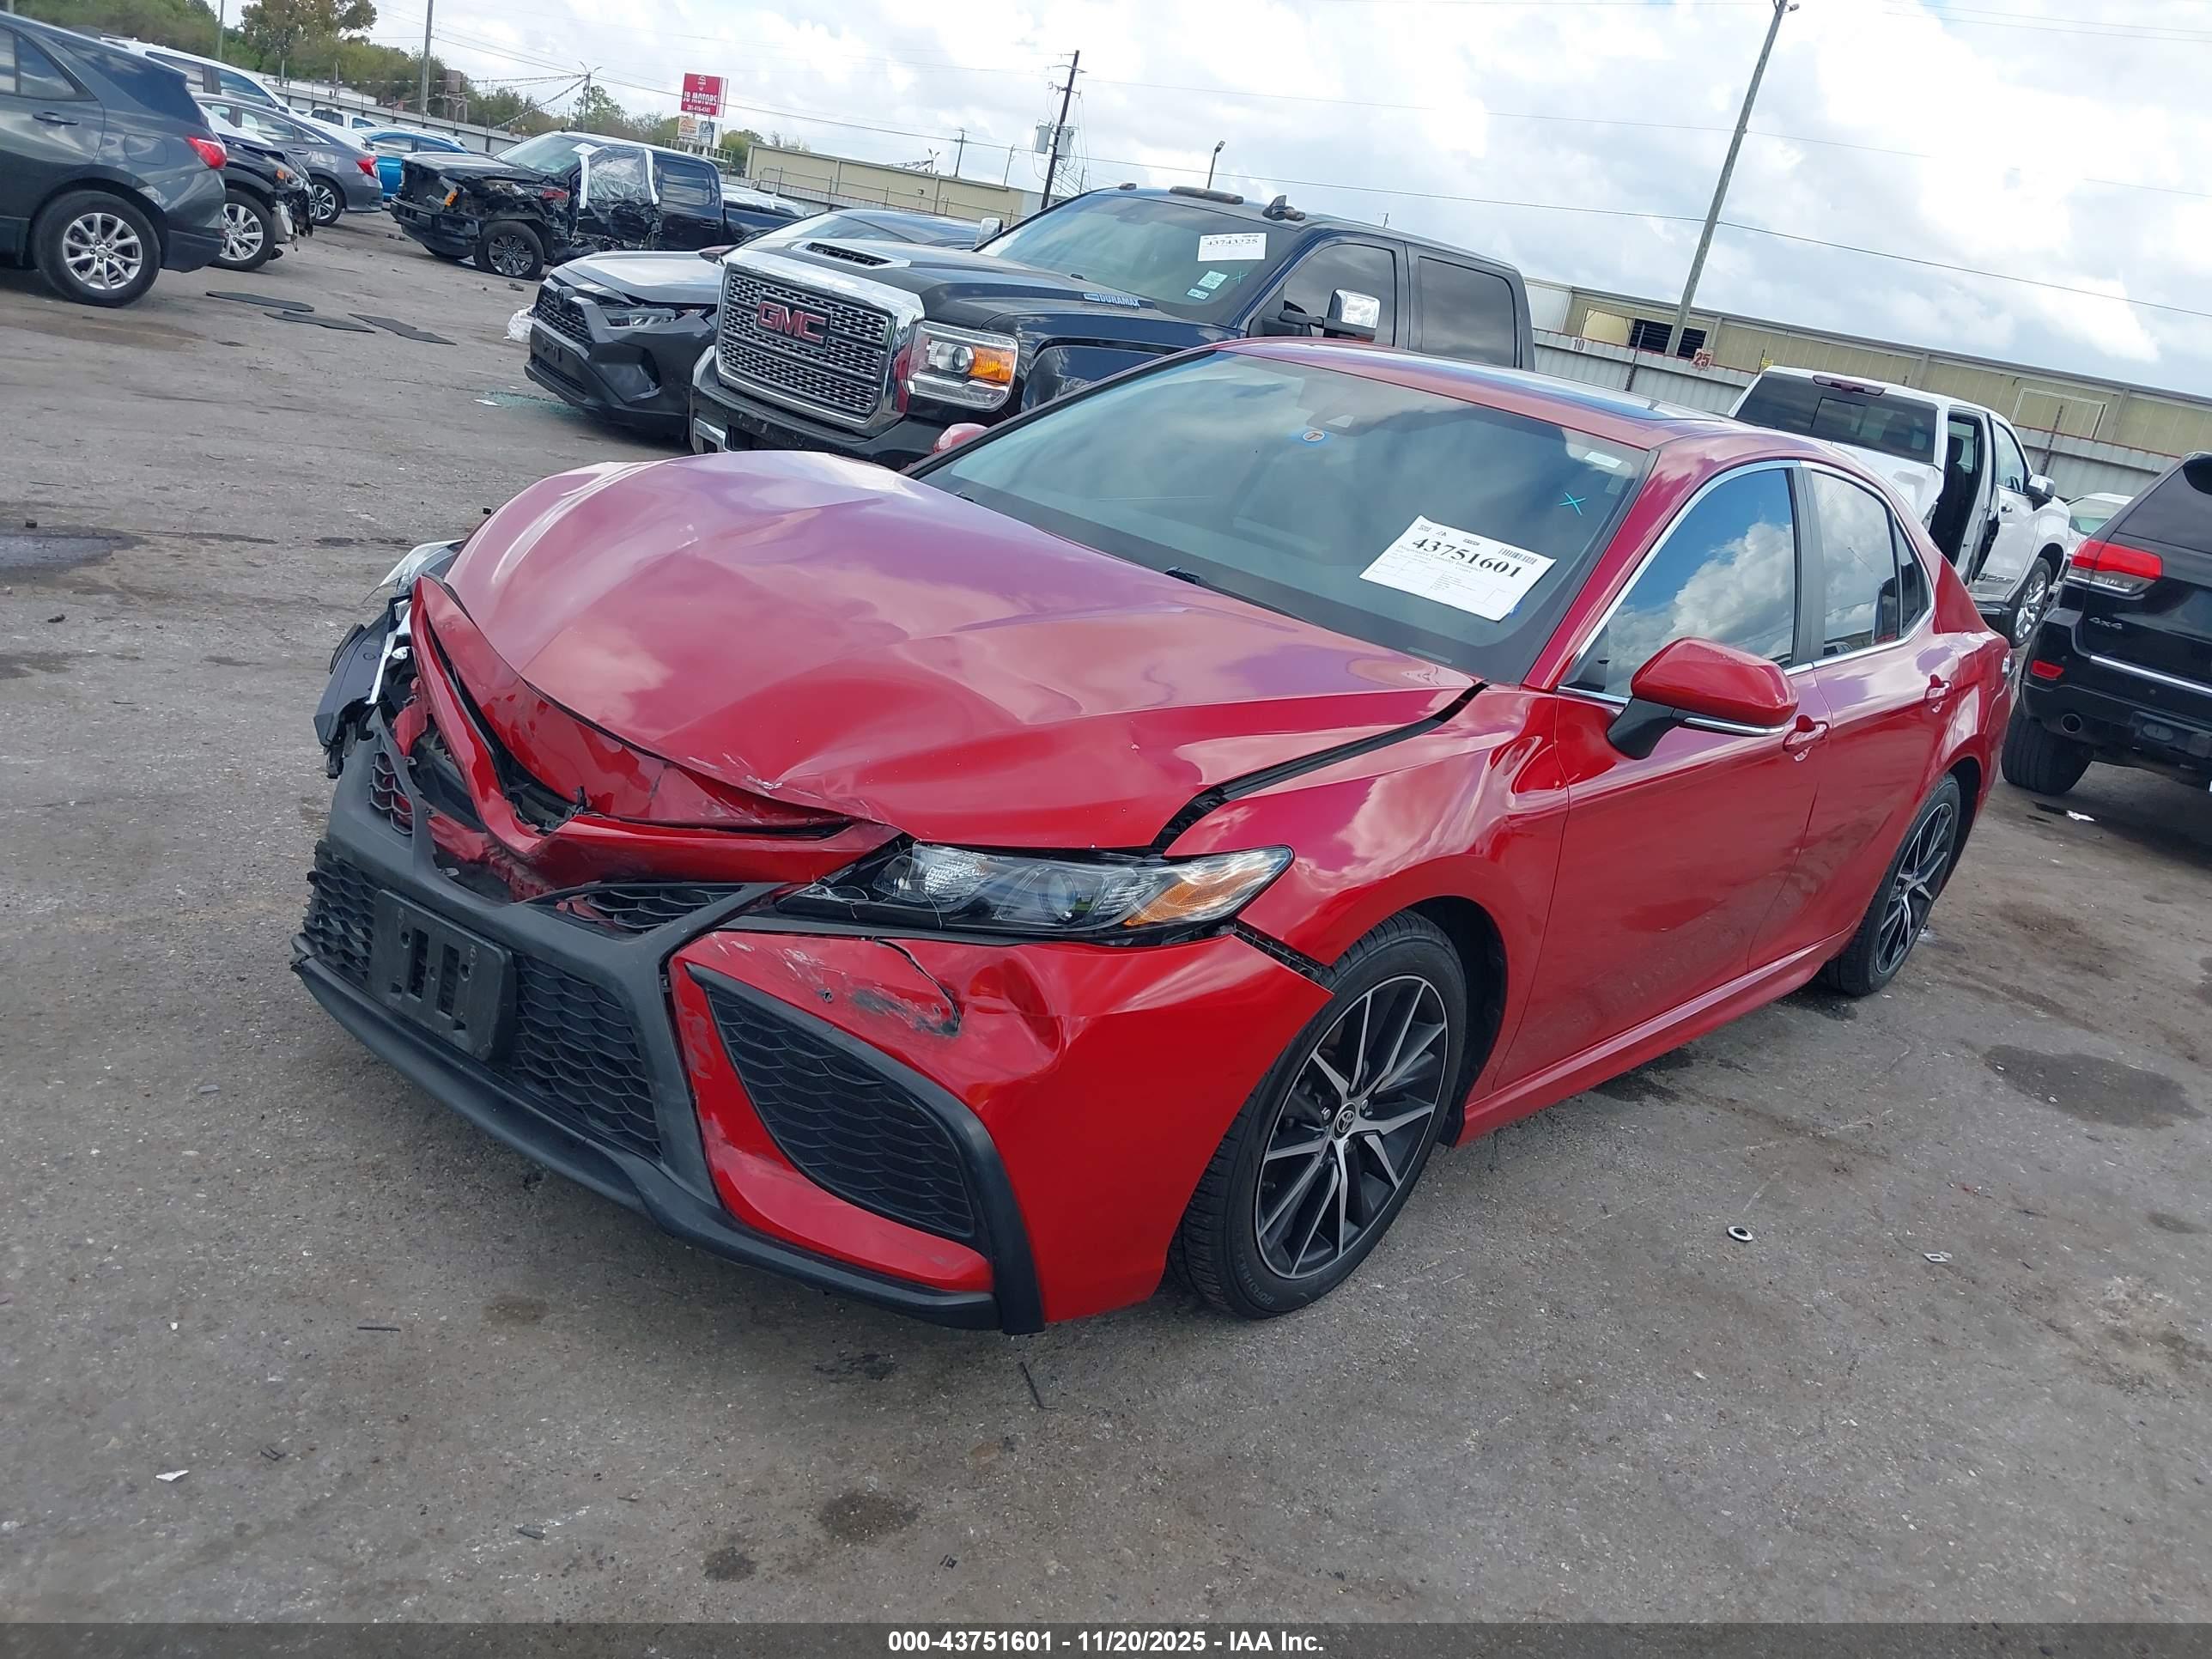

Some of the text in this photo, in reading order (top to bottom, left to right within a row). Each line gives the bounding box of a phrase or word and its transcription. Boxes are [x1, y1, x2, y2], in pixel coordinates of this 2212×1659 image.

[691, 92, 717, 106] MOTORS
[1099, 294, 1140, 307] DURAMAX
[758, 301, 827, 344] GMC
[1573, 338, 1585, 351] 10
[1692, 351, 1711, 368] 25
[1412, 538, 1522, 578] 43751601
